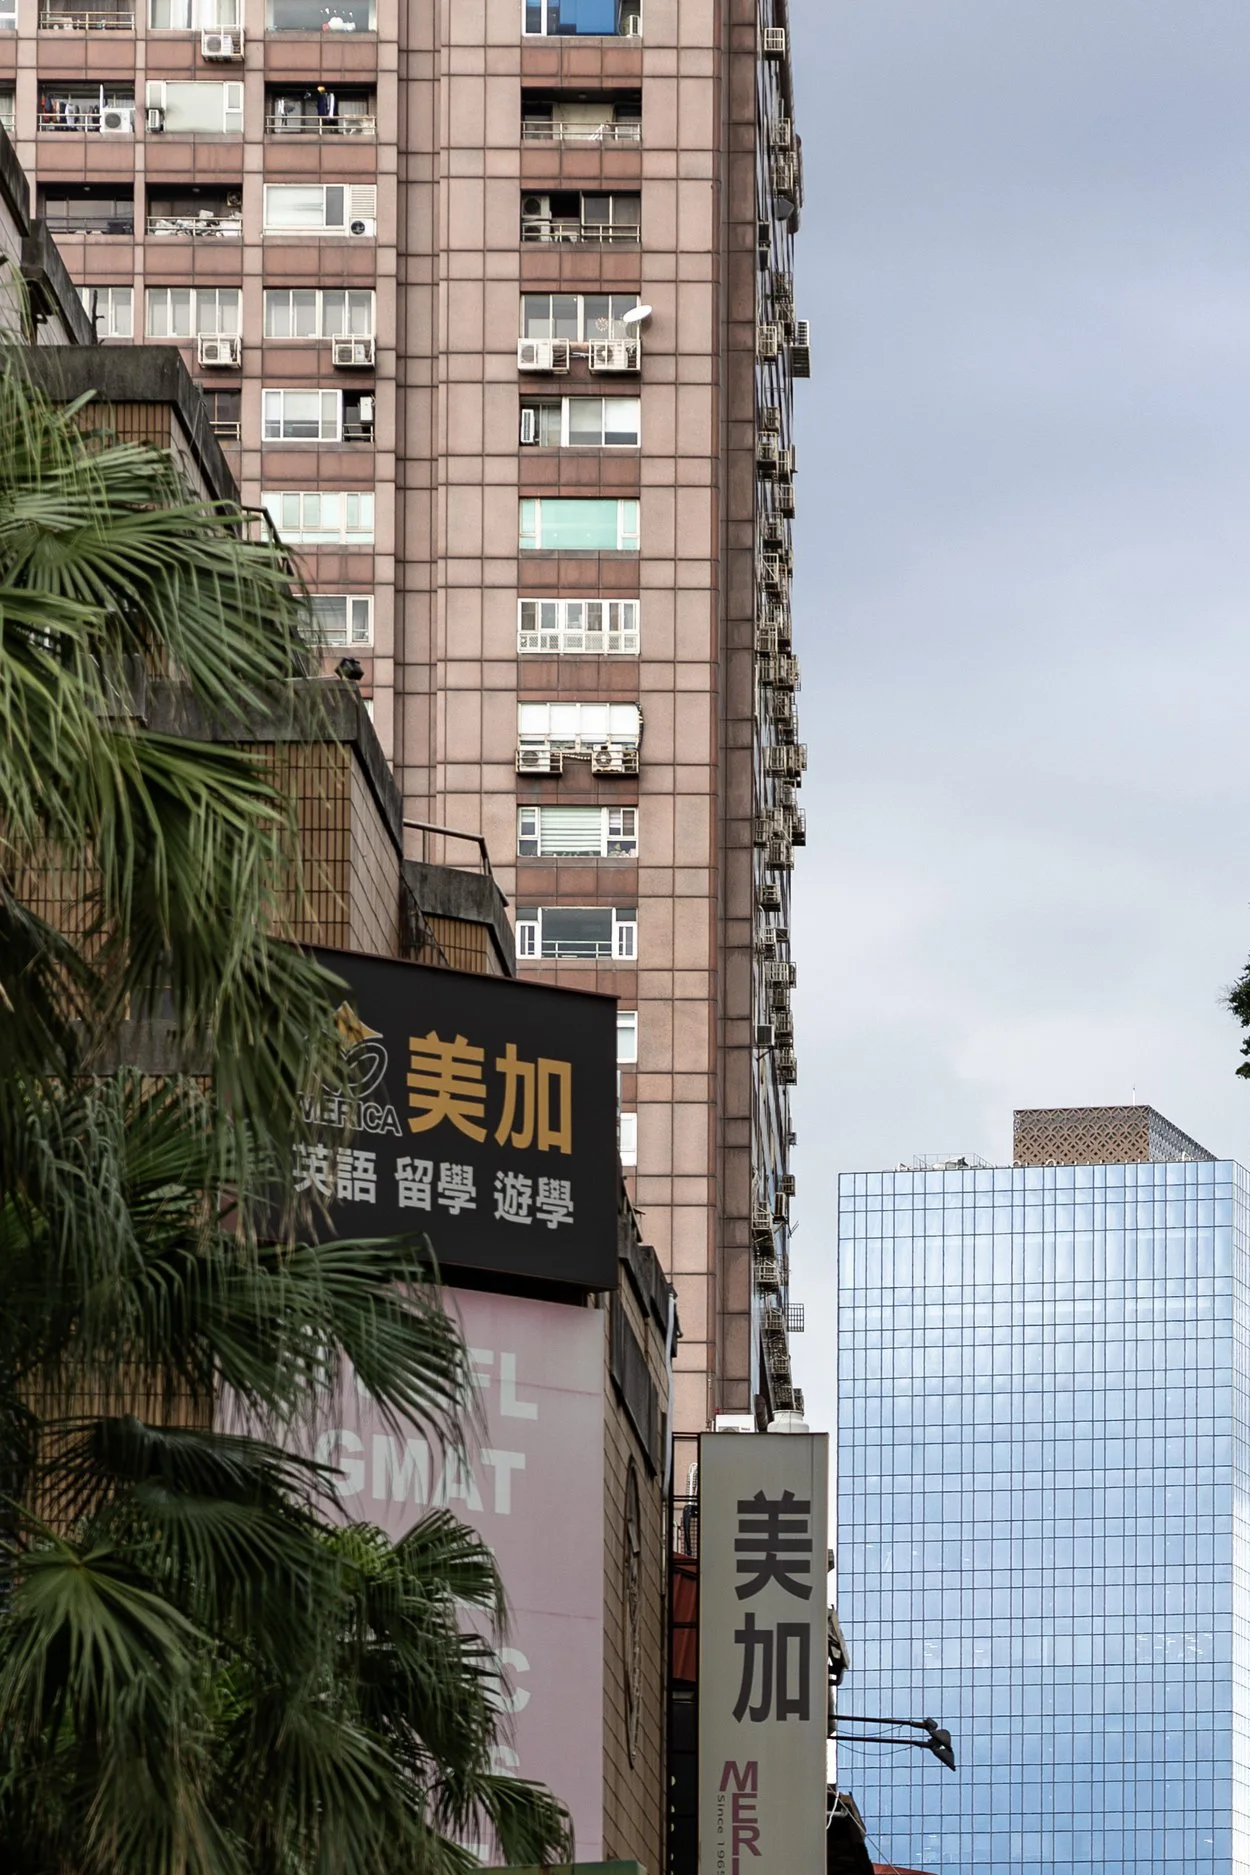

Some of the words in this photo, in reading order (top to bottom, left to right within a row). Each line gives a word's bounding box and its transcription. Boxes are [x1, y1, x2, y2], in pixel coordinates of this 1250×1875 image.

[406, 1030, 573, 1156] 美加
[292, 1142, 378, 1204] 英語
[394, 1155, 477, 1216] 留學
[493, 1170, 575, 1230] 遊學
[315, 1428, 527, 1516] GMAT
[732, 1490, 814, 1724] 美加
[716, 1794, 726, 1834] Since
